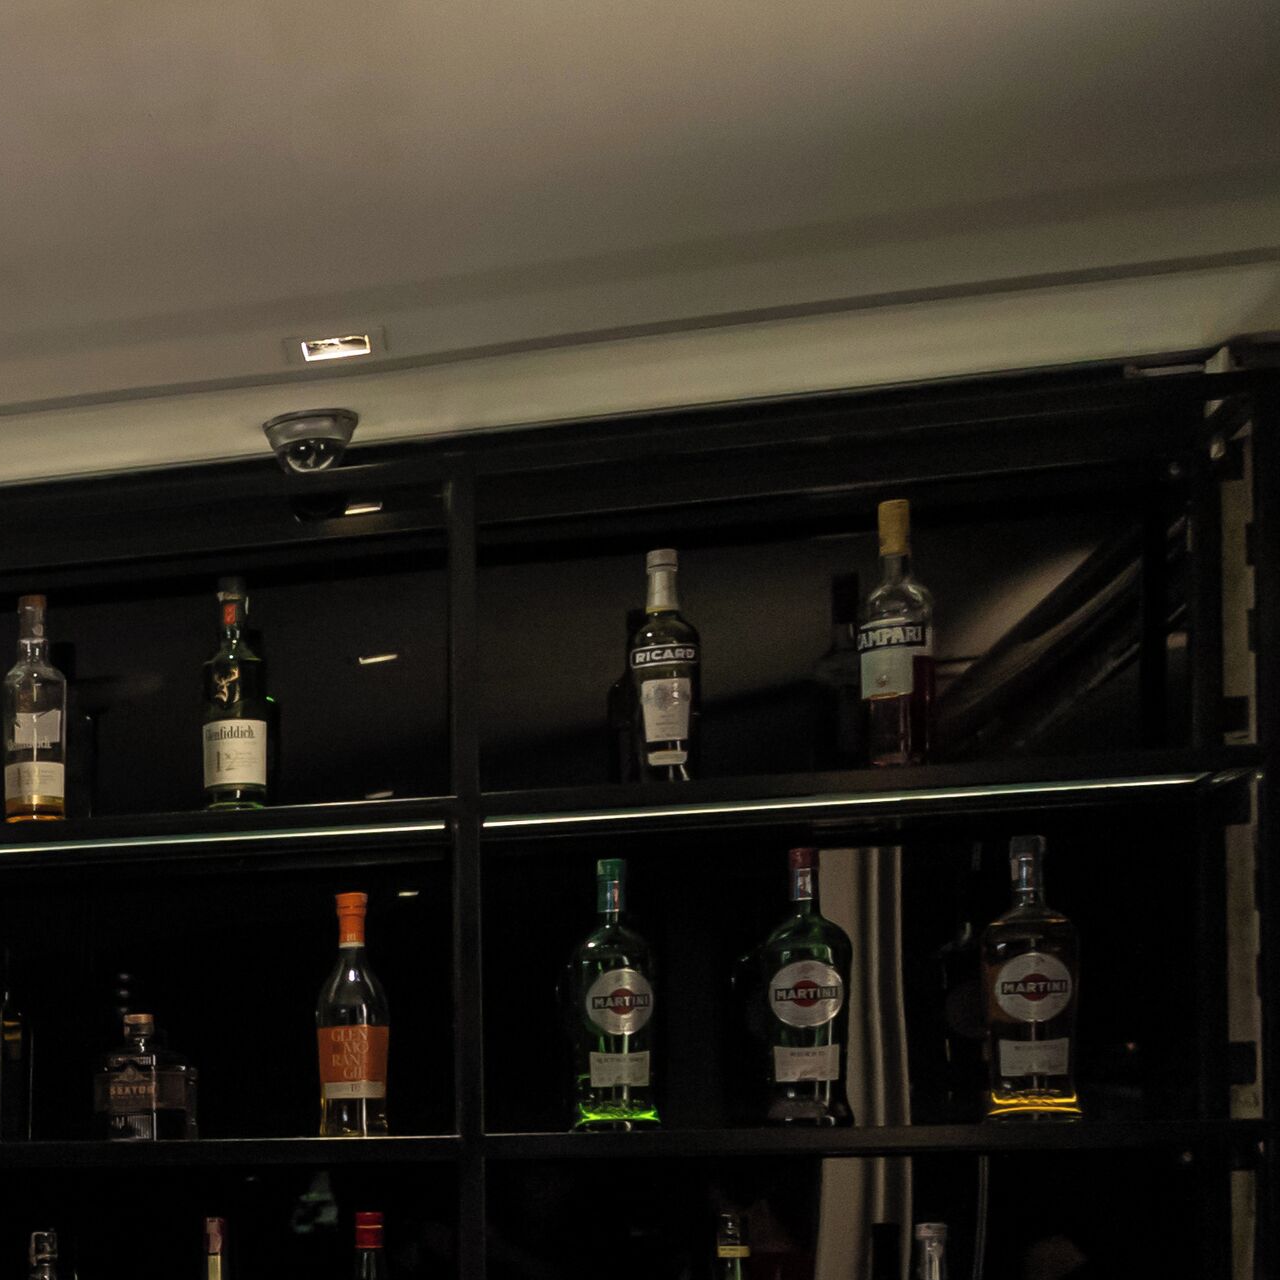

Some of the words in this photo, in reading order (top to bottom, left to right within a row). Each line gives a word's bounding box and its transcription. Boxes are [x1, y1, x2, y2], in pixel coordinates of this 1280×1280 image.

[635, 648, 695, 664] RICARD
[776, 986, 837, 1001] MARTINI
[1001, 981, 1067, 994] MARTINI
[593, 995, 648, 1009] MARTINI
